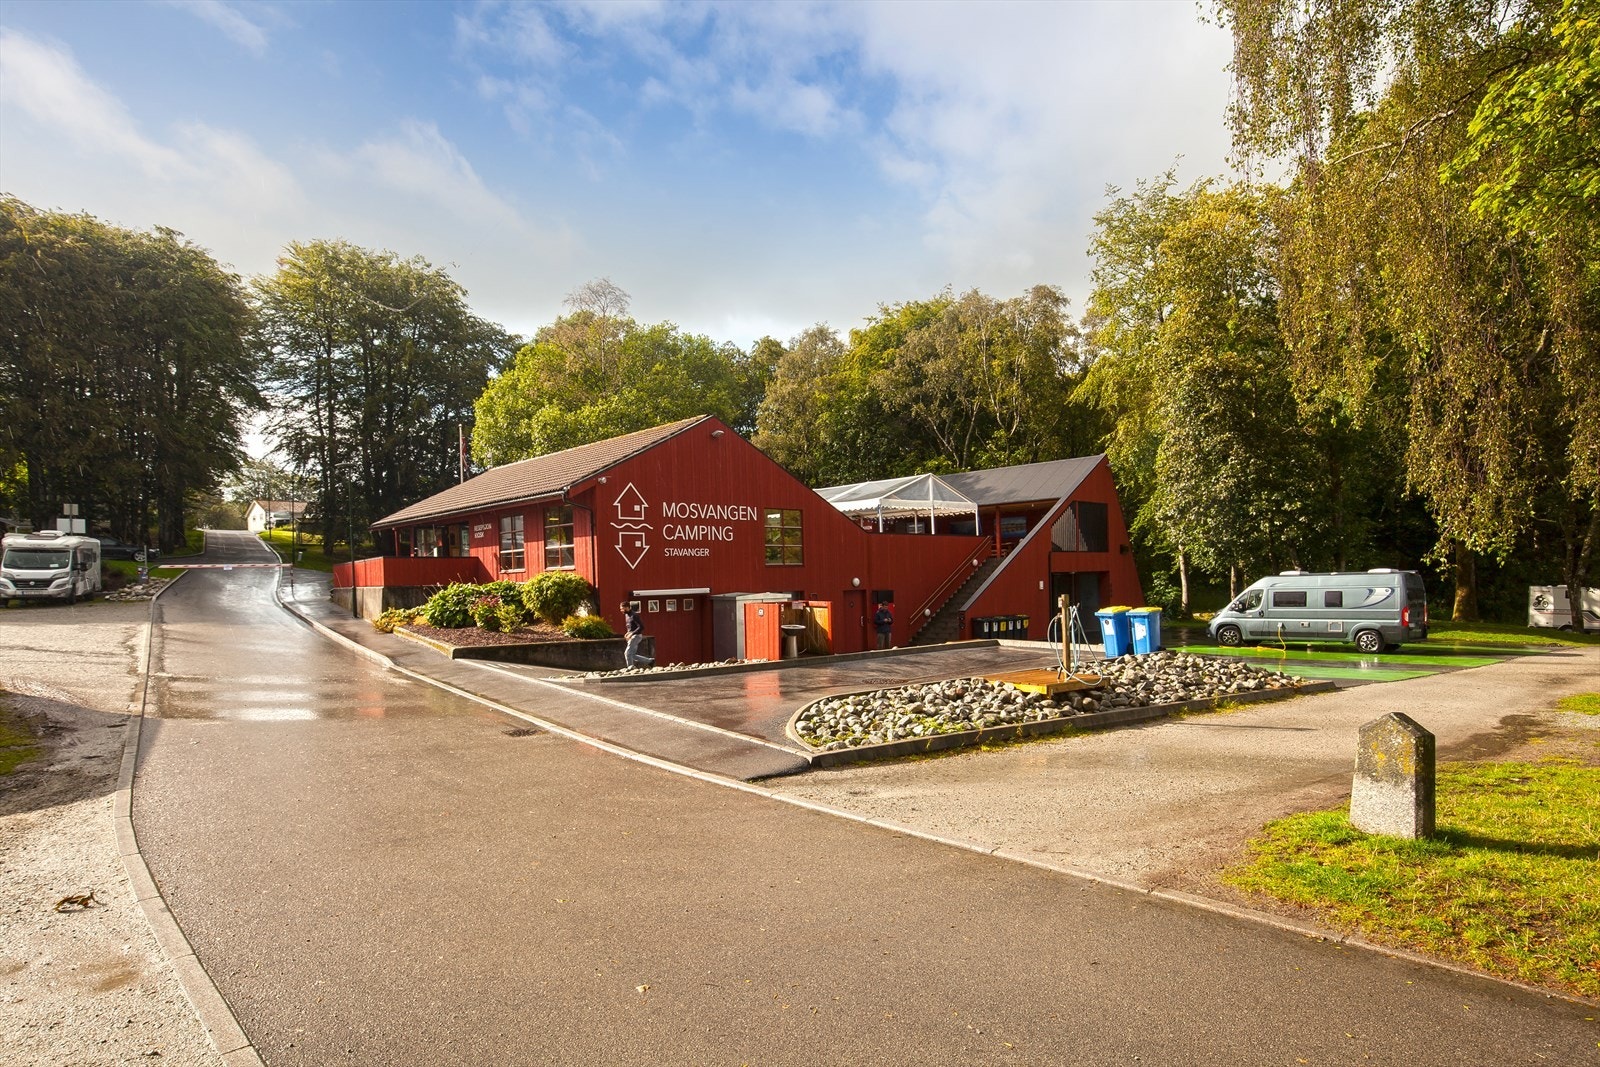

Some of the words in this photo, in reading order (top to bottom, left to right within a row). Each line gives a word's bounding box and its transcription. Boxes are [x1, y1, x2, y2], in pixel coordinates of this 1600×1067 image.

[662, 502, 757, 521] MOSVANGEN
[662, 524, 734, 541] CAMPING
[664, 548, 710, 557] STAVANGER
